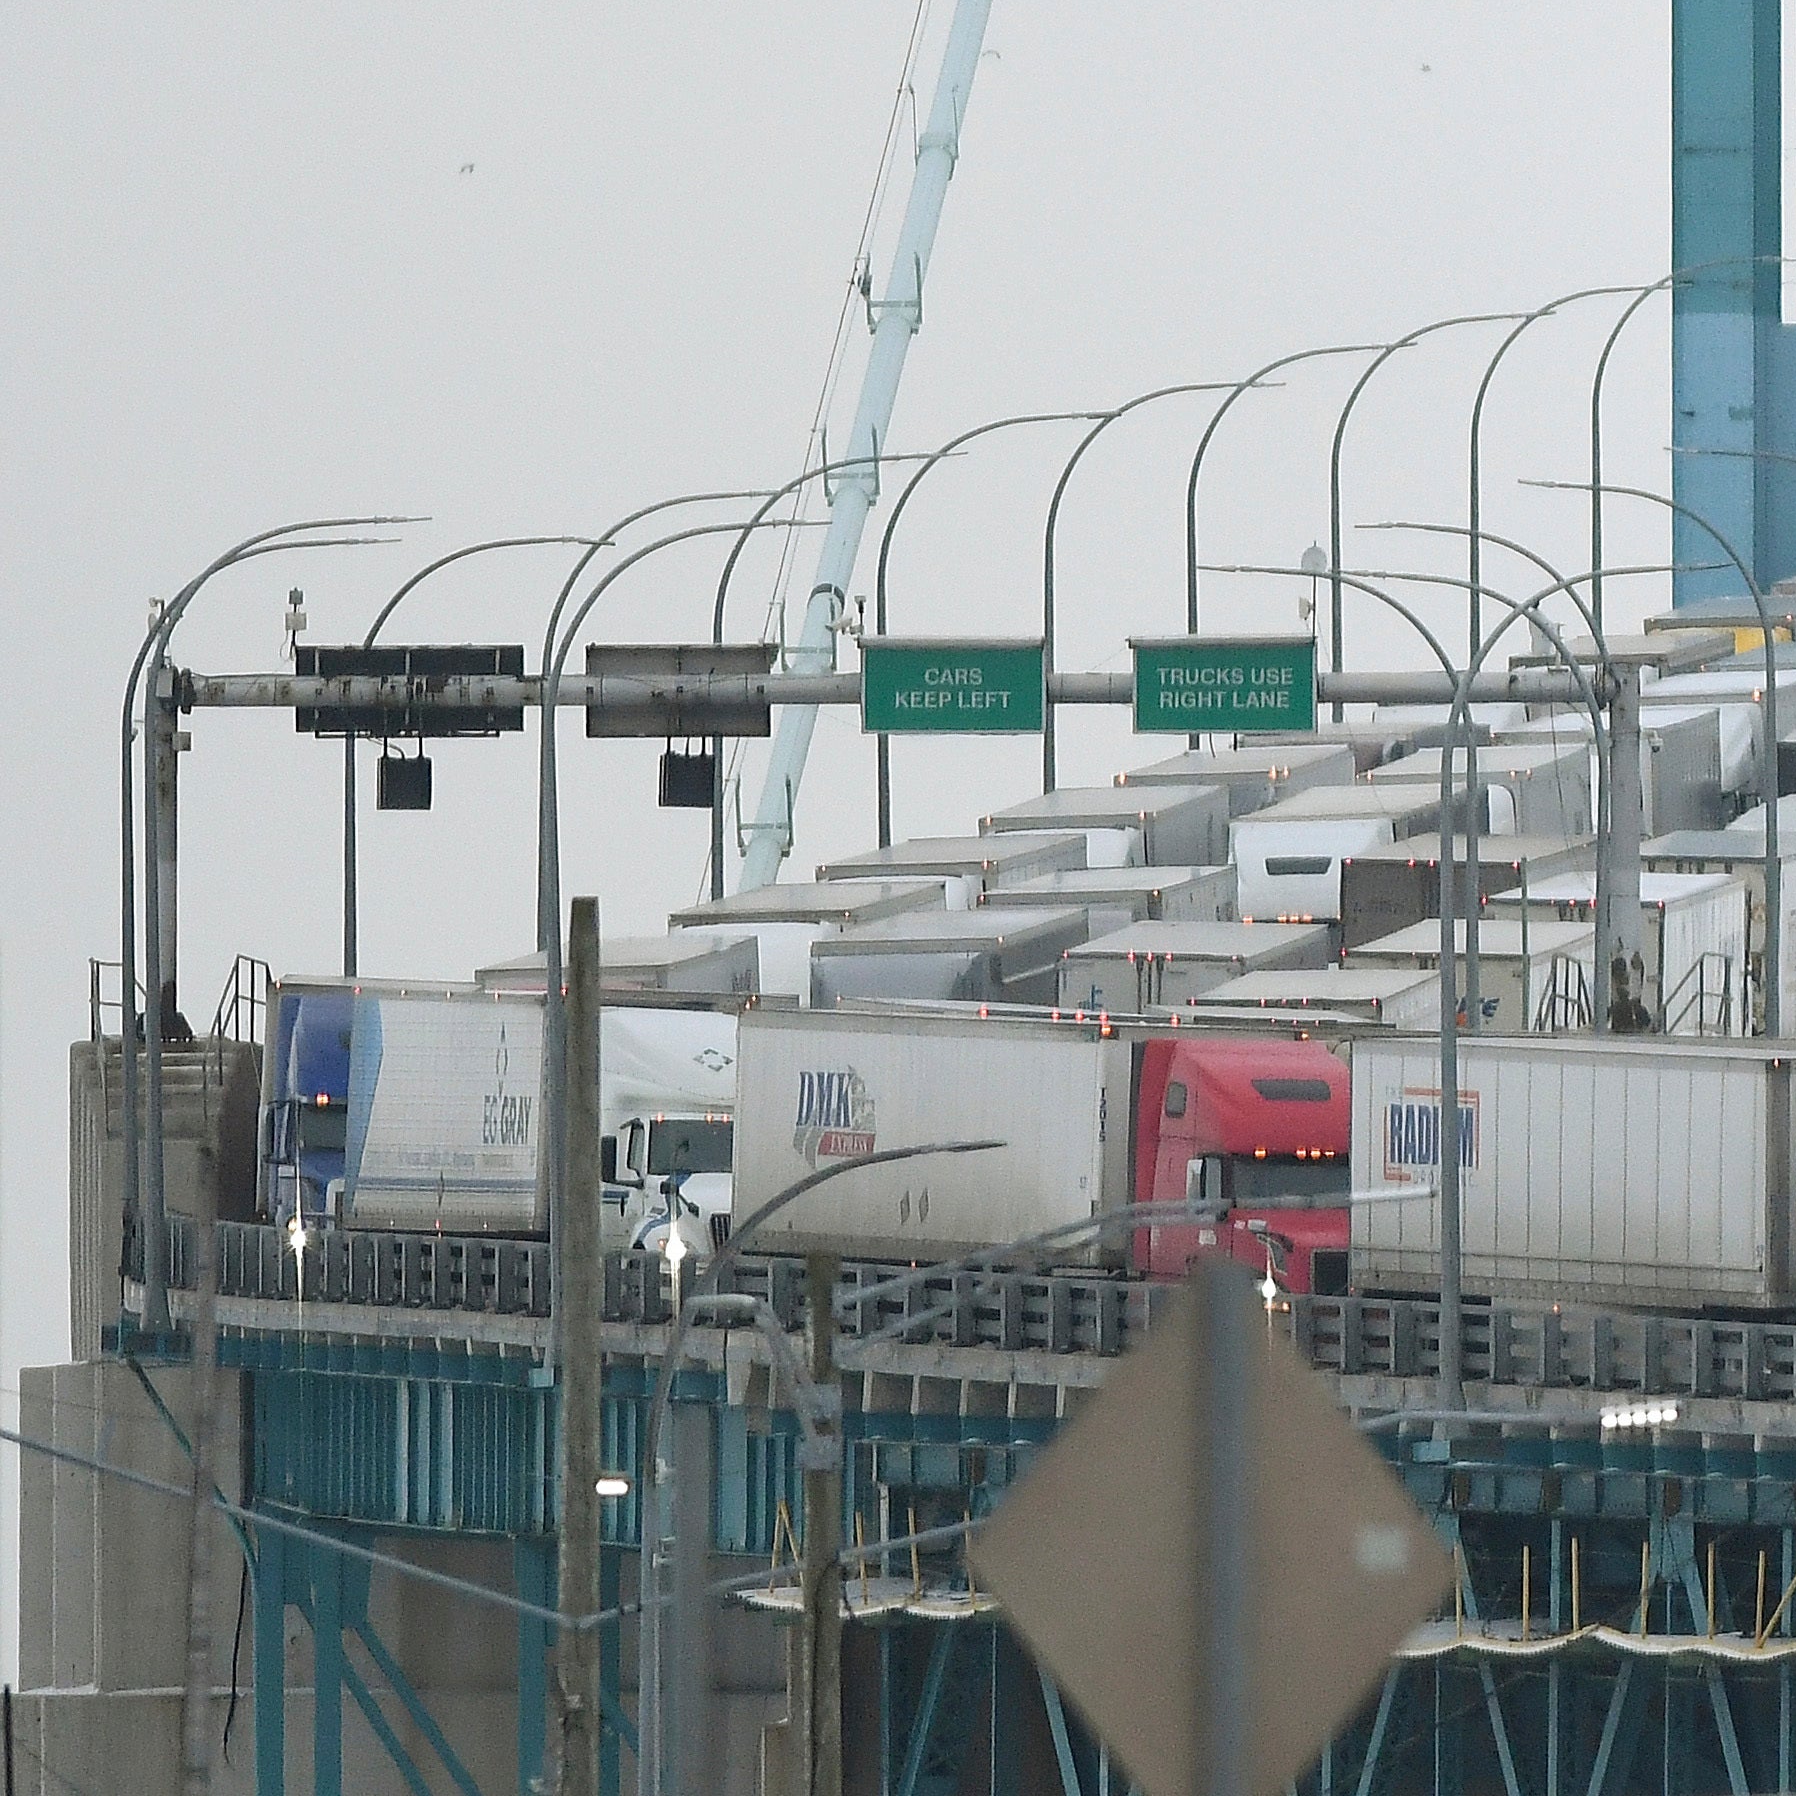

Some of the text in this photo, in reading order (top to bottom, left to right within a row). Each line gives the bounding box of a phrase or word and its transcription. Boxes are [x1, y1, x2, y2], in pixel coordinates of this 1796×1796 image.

[924, 667, 983, 685] CARS
[1157, 667, 1294, 685] TRUCKS USE
[895, 691, 1012, 708] KEEP LEFT
[1159, 691, 1290, 708] RIGHT LANE
[796, 1071, 854, 1127] DMK
[501, 1095, 532, 1145] GRAY
[1389, 1103, 1474, 1167] RADIM
